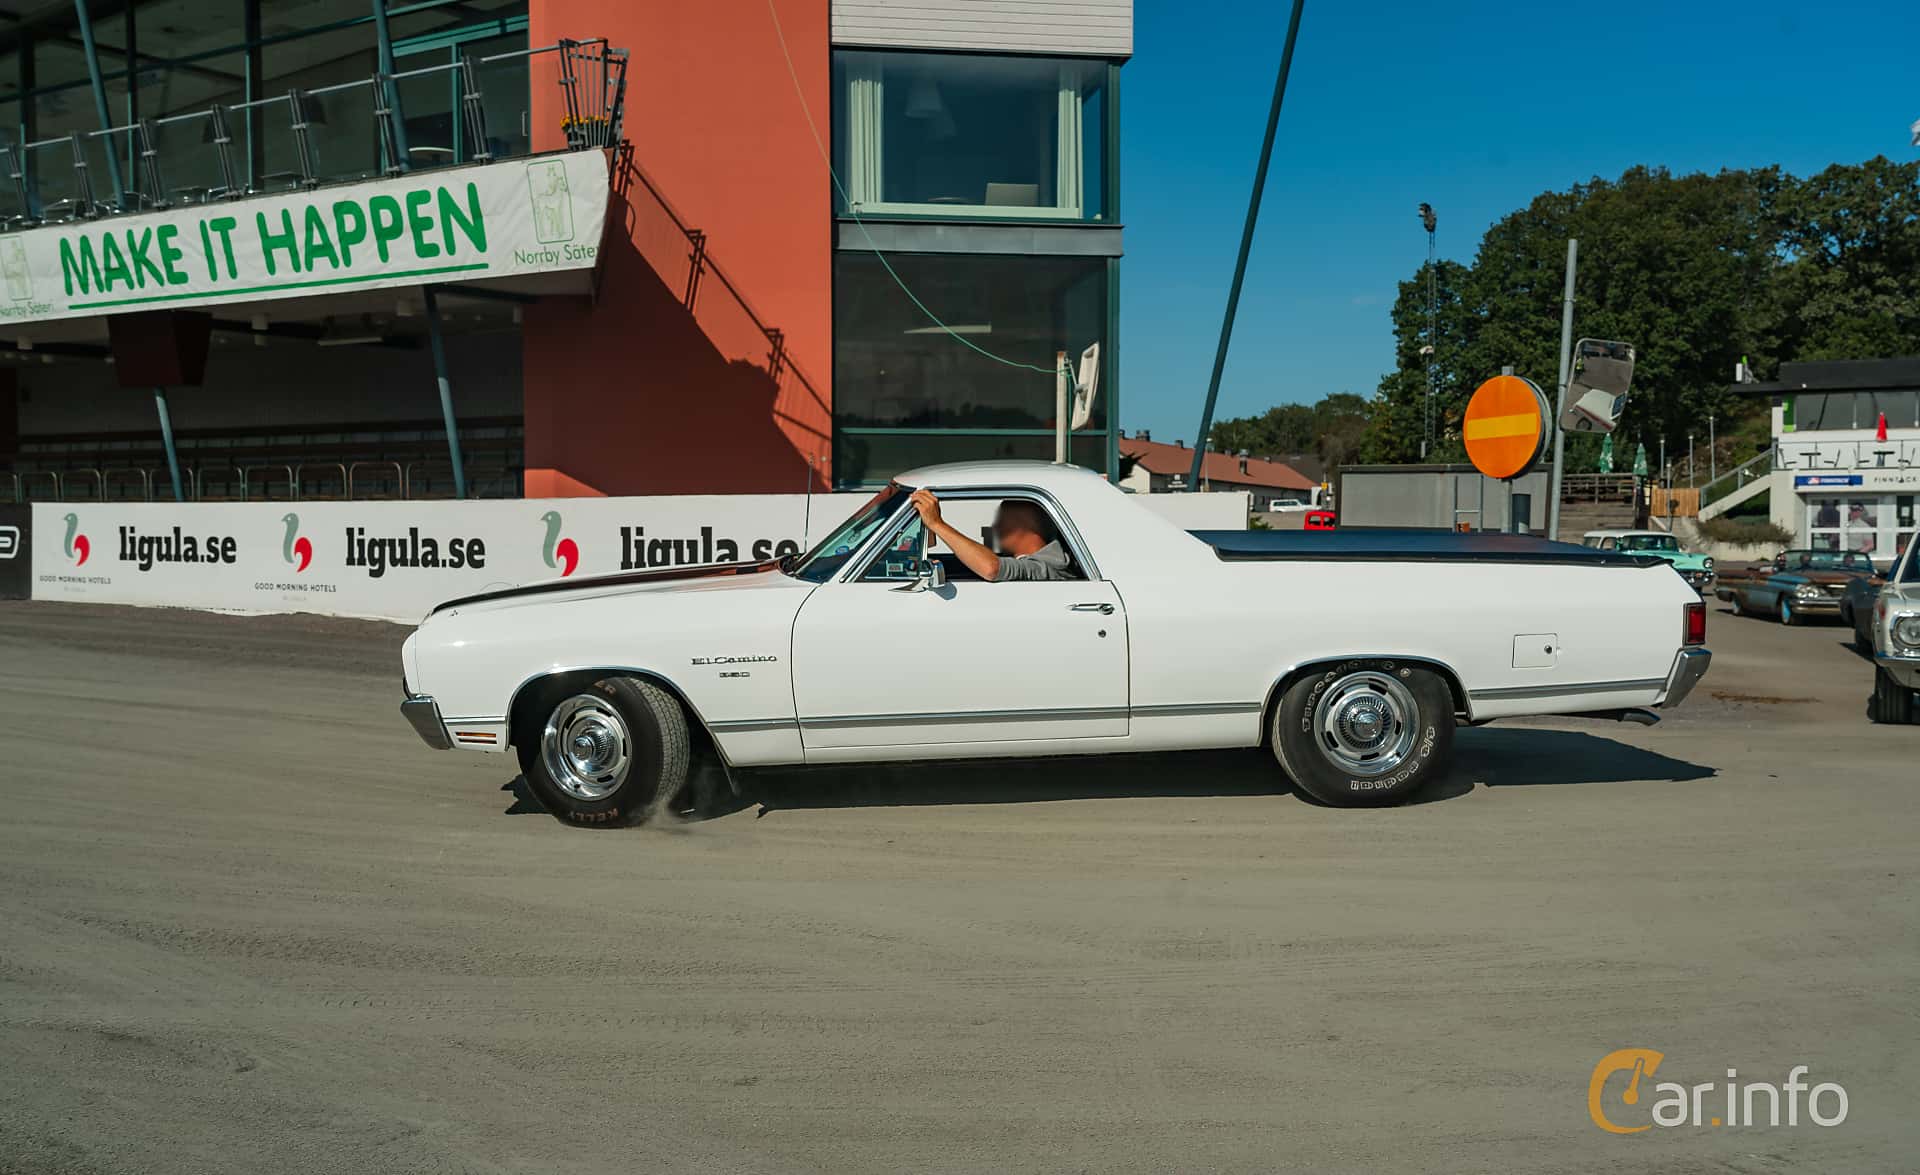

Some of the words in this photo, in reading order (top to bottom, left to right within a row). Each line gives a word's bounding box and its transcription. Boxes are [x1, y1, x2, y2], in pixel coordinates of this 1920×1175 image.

[60, 224, 190, 296] MAKE
[200, 217, 238, 282] IT
[256, 183, 488, 277] HAPPEN
[513, 245, 560, 267] Norrby
[119, 526, 237, 572] ligula.se
[345, 527, 486, 579] ligula.se
[620, 526, 800, 570] ligulase
[254, 582, 274, 591] GOOD
[276, 583, 308, 593] MORNING
[310, 584, 337, 593] HOTELS
